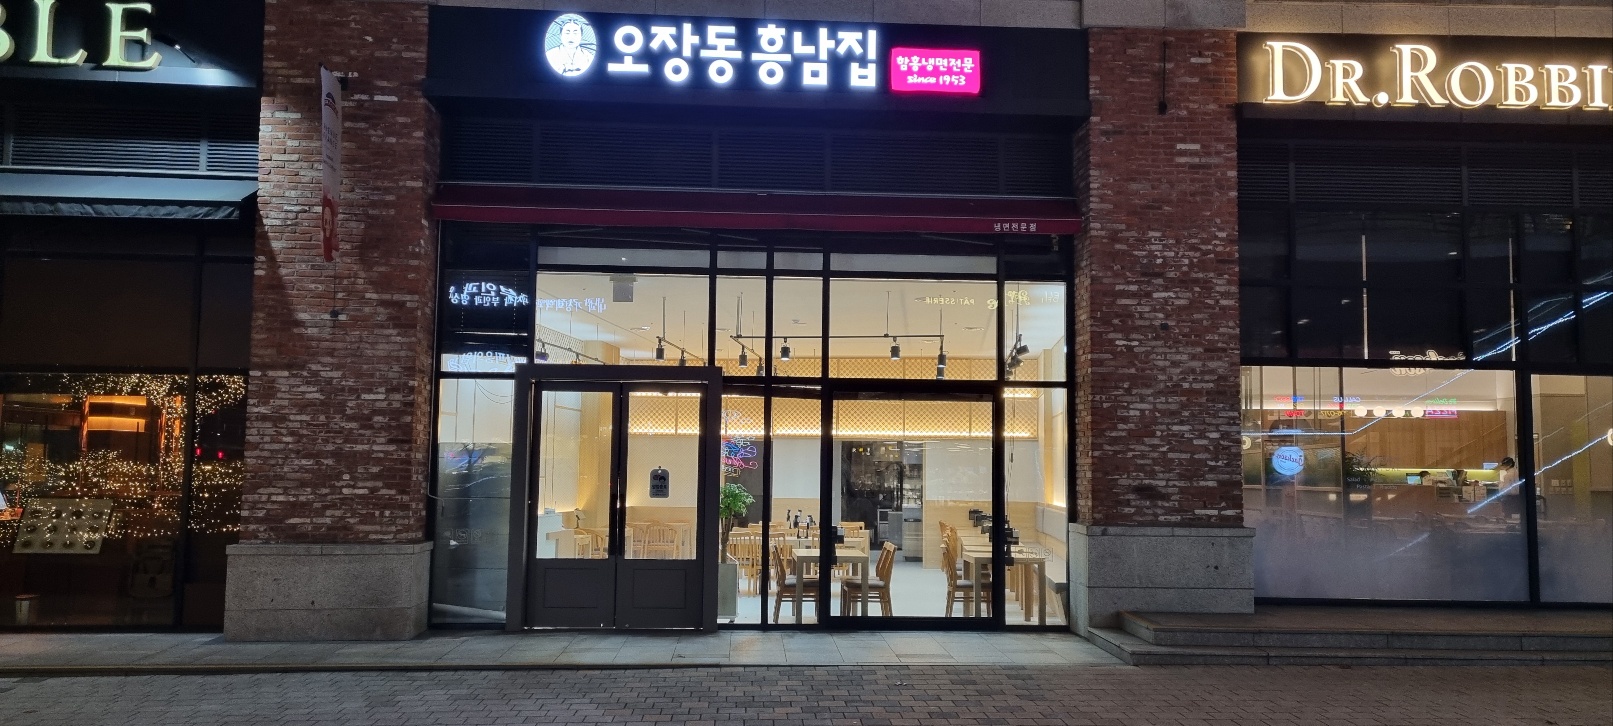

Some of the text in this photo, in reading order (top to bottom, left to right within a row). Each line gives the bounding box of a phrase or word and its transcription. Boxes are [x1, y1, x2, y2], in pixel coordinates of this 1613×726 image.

[606, 23, 877, 89] 오장동 흥남집
[1262, 40, 1613, 110] DR.ROBBI
[906, 74, 966, 86] since 1953
[993, 222, 1037, 232] 냉면전문점
